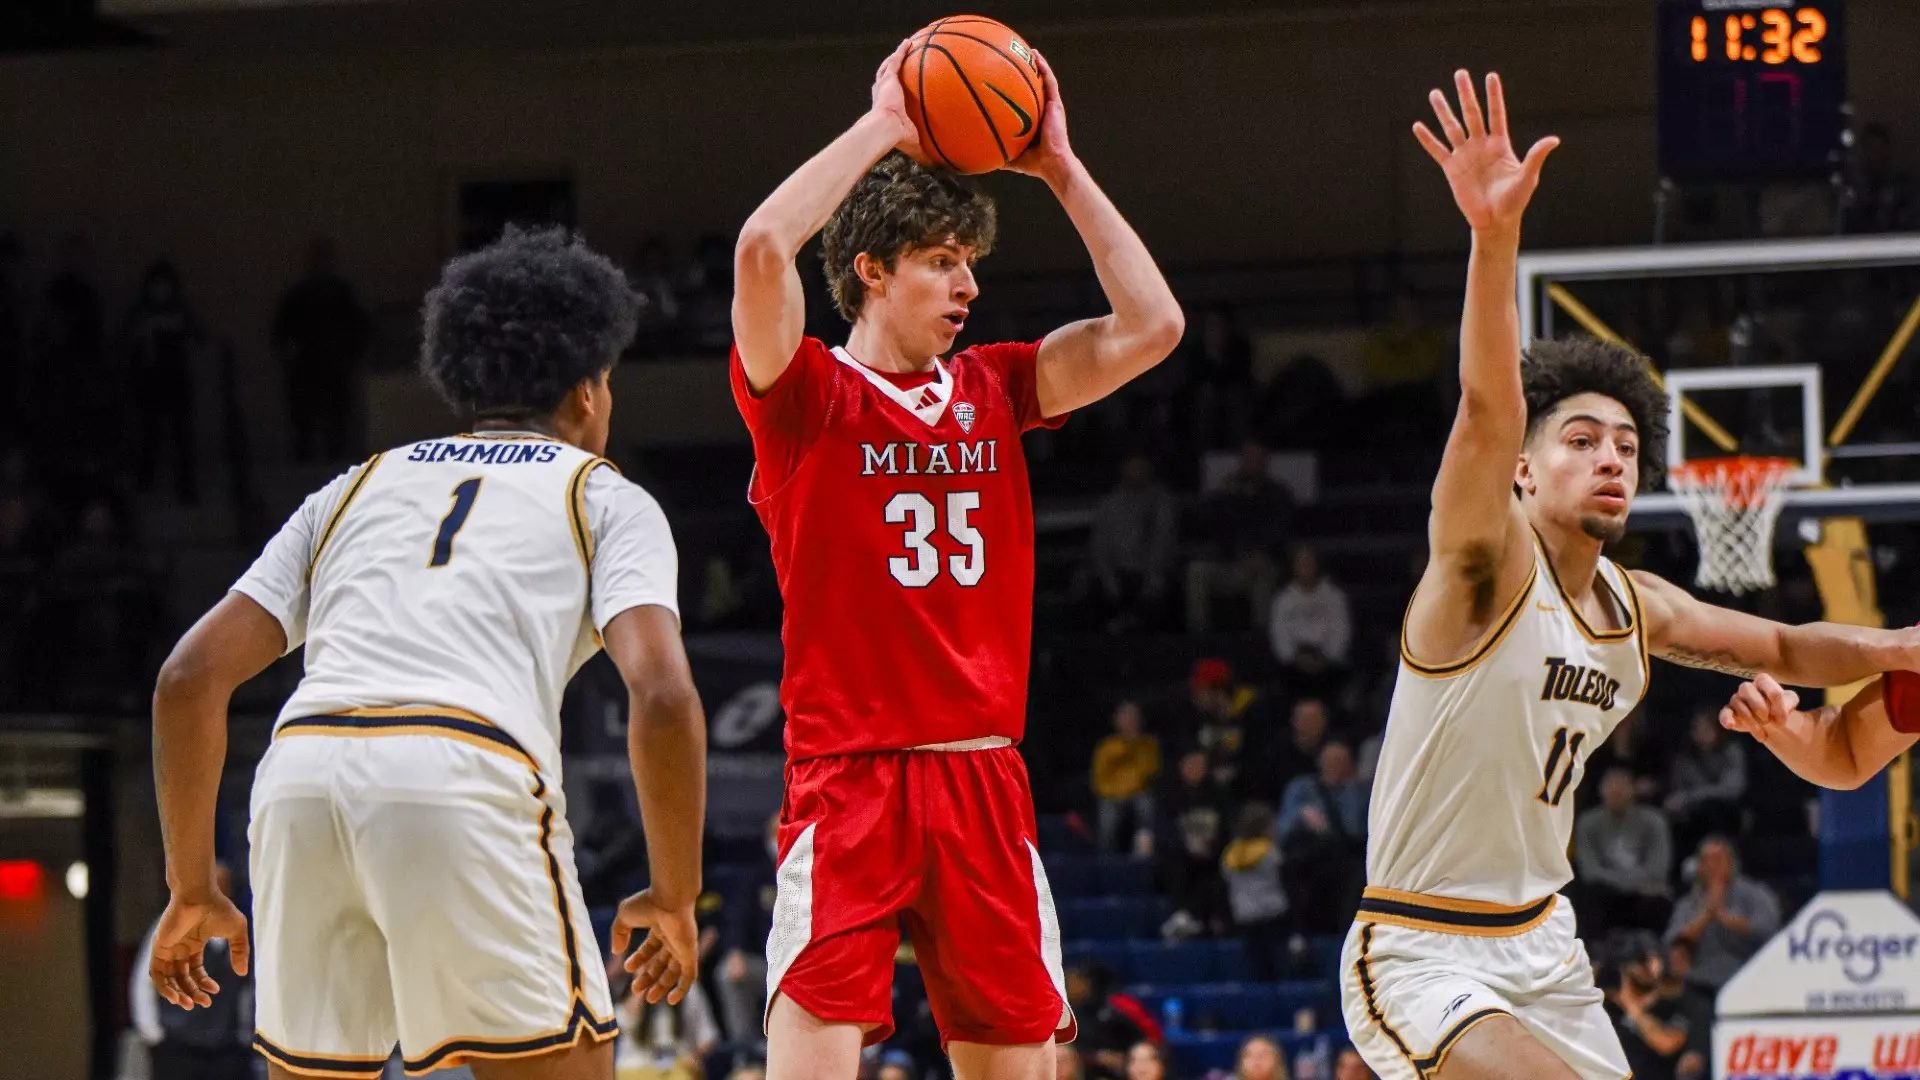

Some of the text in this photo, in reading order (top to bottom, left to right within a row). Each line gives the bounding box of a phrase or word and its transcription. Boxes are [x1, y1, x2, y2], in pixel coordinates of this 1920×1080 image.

[1690, 7, 1827, 64] 11:32
[407, 442, 563, 465] SIMMONS
[860, 438, 999, 476] MIAMI
[426, 475, 485, 569] 1
[883, 489, 986, 589] 35
[1536, 726, 1586, 808] 11
[1788, 909, 1918, 985] Kroger
[1726, 1030, 1839, 1075] dave
